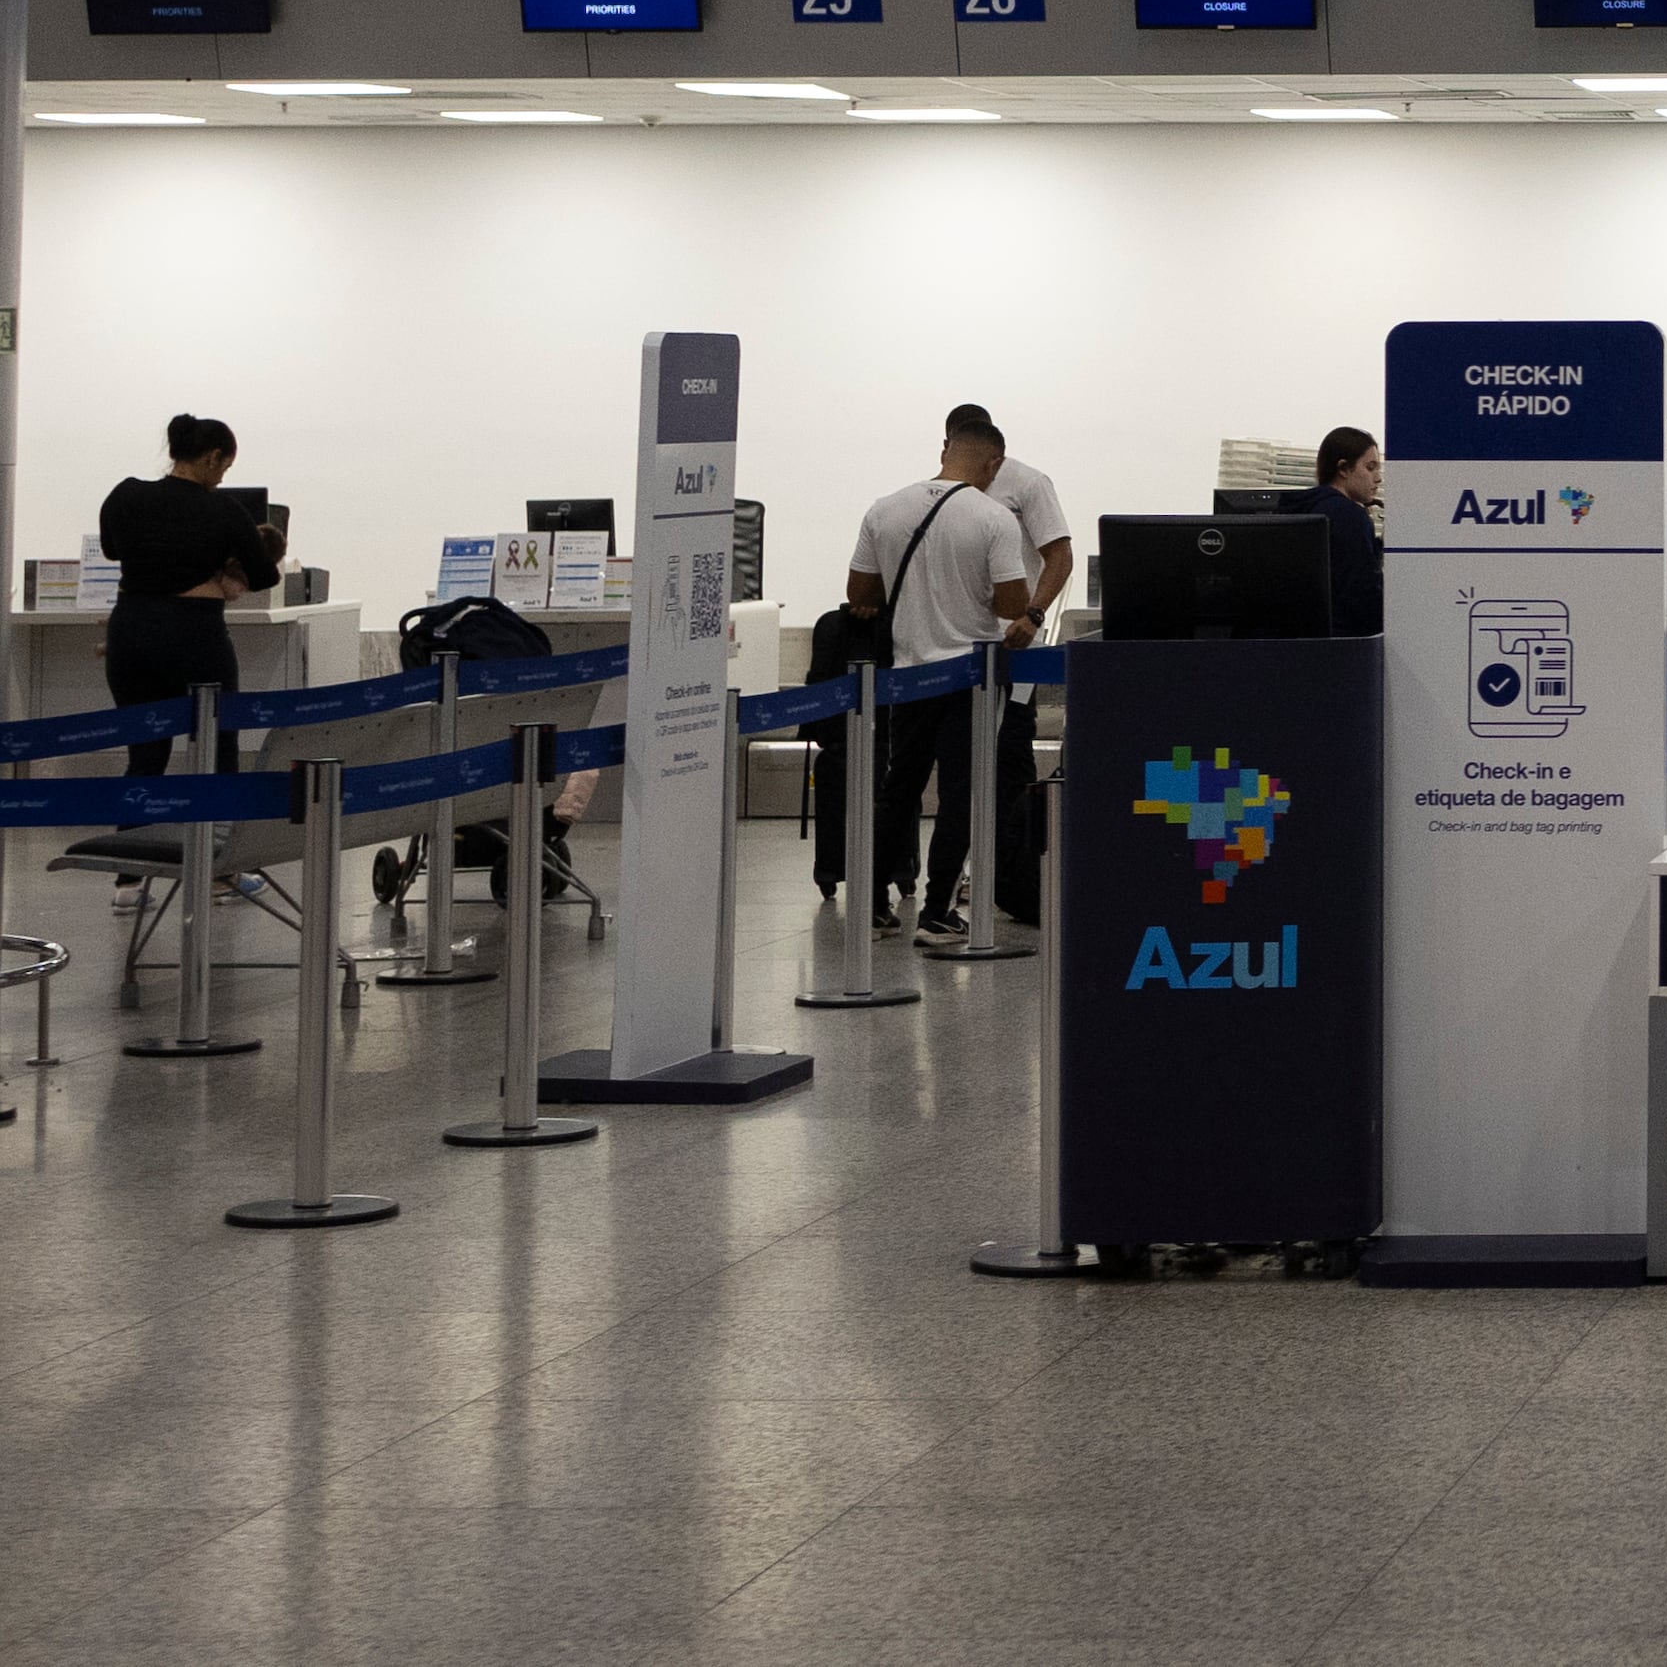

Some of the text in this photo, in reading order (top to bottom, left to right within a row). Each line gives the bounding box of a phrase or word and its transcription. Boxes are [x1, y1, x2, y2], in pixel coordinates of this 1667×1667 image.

[585, 4, 636, 15] PRIORITIES
[1203, 2, 1247, 11] CLOSURE
[1464, 364, 1583, 386] CHECK-IN
[1477, 390, 1571, 416] RÁPIDO
[674, 465, 704, 494] Azul
[1450, 489, 1546, 526] Azul
[1463, 761, 1572, 780] Check-in e
[1414, 788, 1625, 811] etiqueta de bagagem
[1428, 820, 1603, 835] Check-in and bag tag printing
[1124, 924, 1299, 990] Azul
